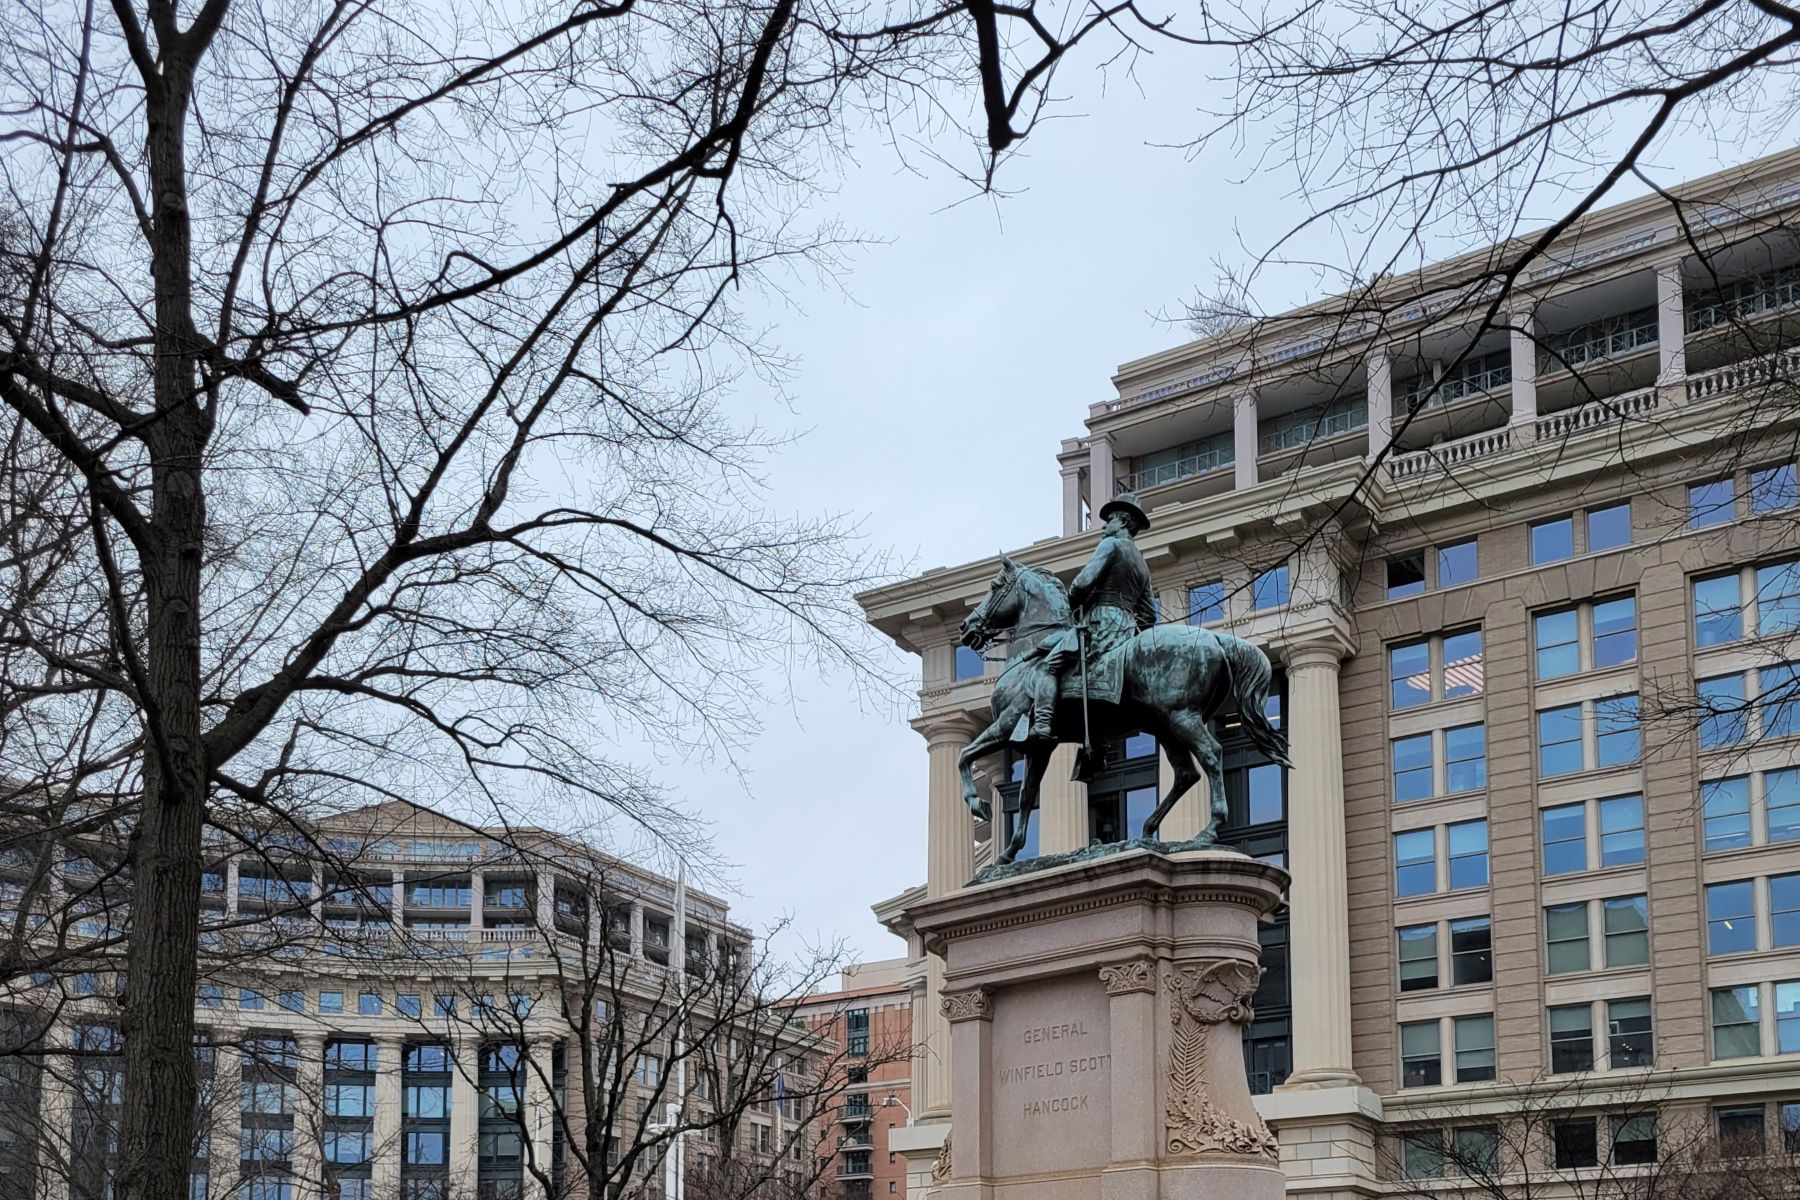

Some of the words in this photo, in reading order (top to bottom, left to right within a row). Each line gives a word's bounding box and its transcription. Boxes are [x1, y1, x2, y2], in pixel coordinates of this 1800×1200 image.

[1023, 1021, 1088, 1044] GENERAL
[1000, 1062, 1063, 1084] WINFIELD
[1023, 1095, 1088, 1118] HANCOCK
